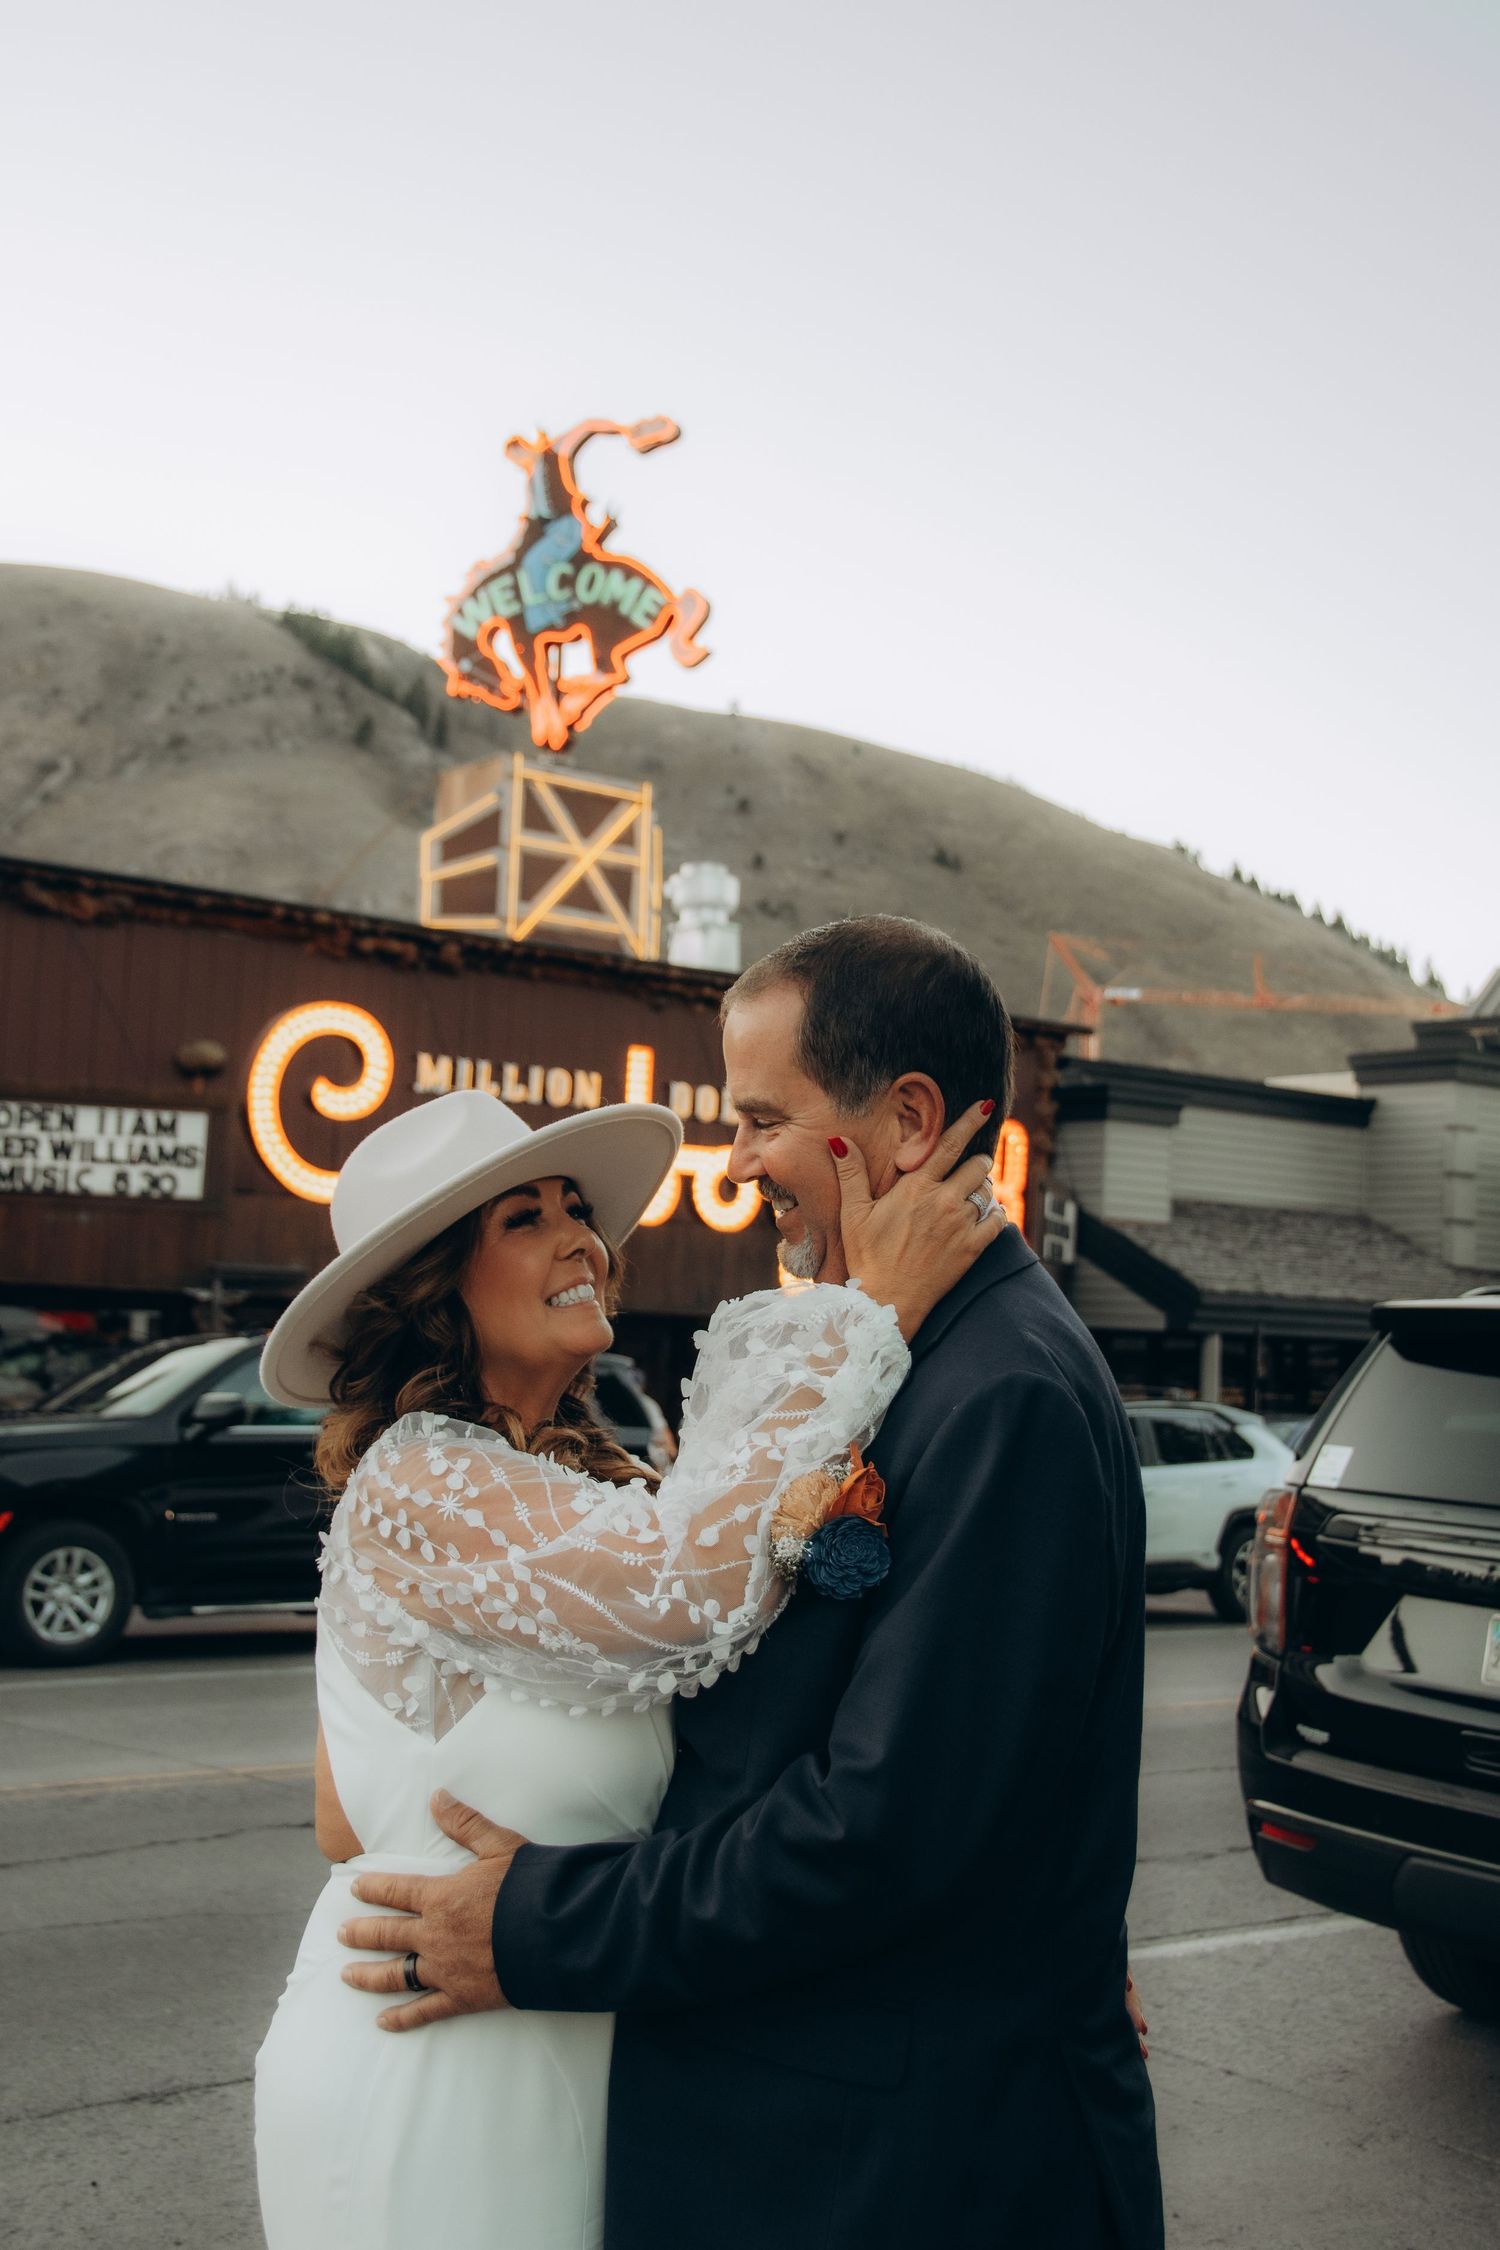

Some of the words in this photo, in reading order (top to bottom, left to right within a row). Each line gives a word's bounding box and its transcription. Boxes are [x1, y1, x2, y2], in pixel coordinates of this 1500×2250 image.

[453, 561, 667, 640] WELCOME
[414, 1051, 602, 1109] MILLION
[0, 1101, 75, 1132] OPEN
[50, 1137, 198, 1168] WILLIAMS
[0, 1163, 93, 1195] MUSIC
